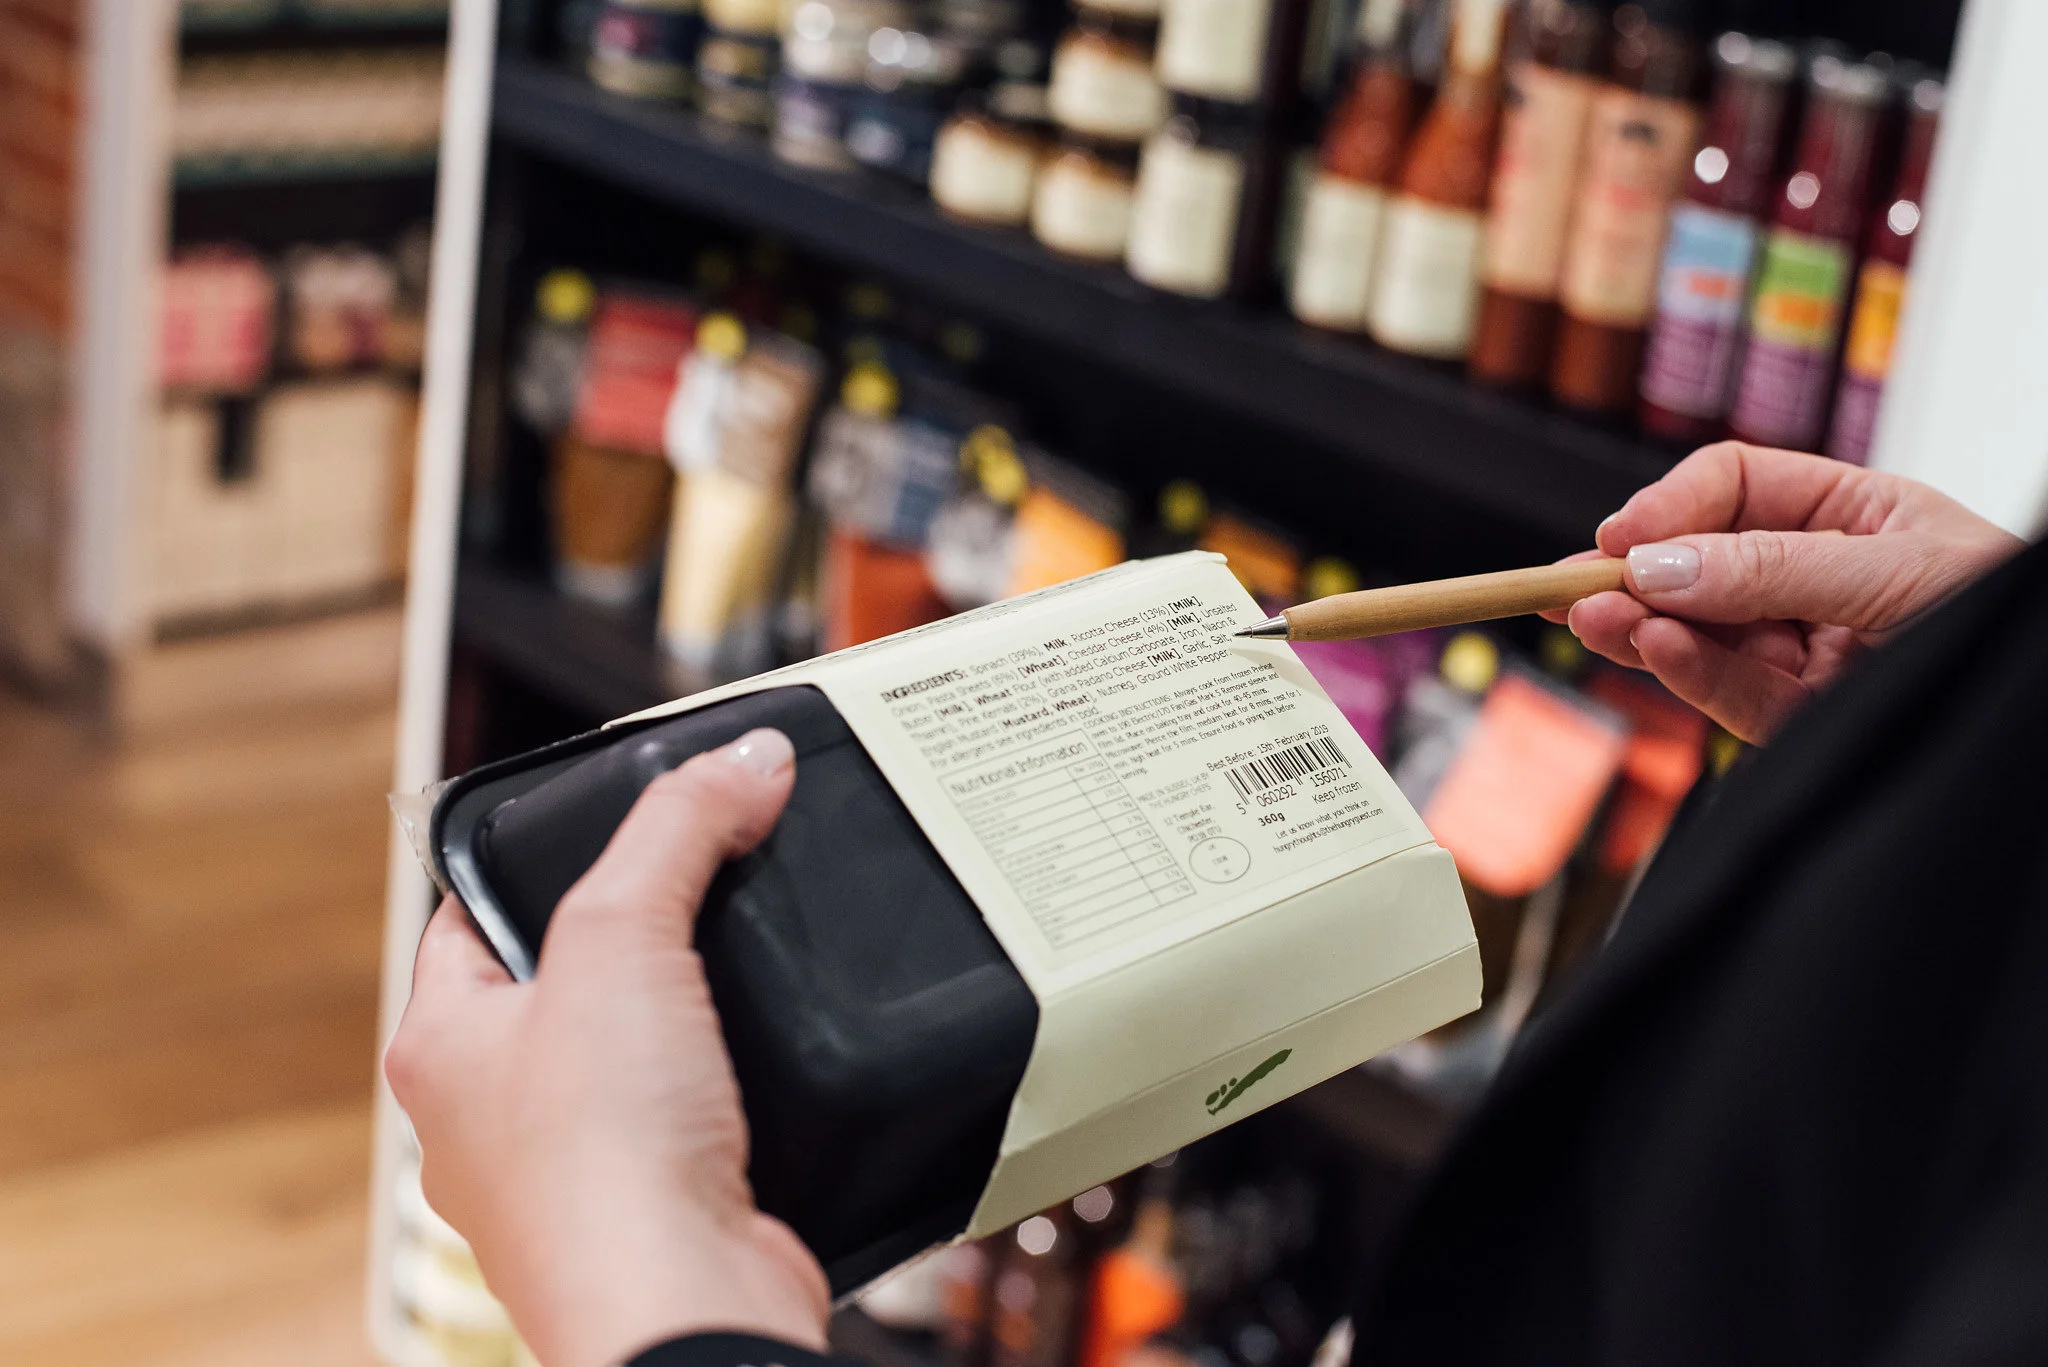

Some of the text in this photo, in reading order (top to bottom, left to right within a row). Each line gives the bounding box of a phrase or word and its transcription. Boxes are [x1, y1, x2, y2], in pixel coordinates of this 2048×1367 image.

[881, 670, 968, 701] INGREDIENTS:
[969, 657, 1008, 675] Spinach
[1043, 638, 1071, 651] Milk,
[1070, 627, 1105, 642] Ricotta
[1104, 616, 1140, 632] Cheese
[1138, 605, 1171, 622] (13%)
[1167, 595, 1203, 614] [Milk],
[955, 680, 992, 696] Sheets
[1017, 654, 1068, 678] [Wheat],
[1067, 642, 1107, 660] Cheddar
[1107, 631, 1144, 647] Cheese
[1142, 621, 1169, 638] (4%)
[1166, 612, 1202, 630] [Milk],
[1200, 603, 1237, 618] Unsalted
[976, 689, 1012, 705] Wheat
[1011, 680, 1036, 693] Flour
[1037, 671, 1064, 687] (with
[1063, 660, 1094, 677] added
[1092, 650, 1130, 667] Calcium
[1128, 636, 1180, 656] Carbonate,
[1178, 628, 1203, 640] Iron,
[1201, 619, 1229, 632] Niacin
[1047, 683, 1078, 698] Grana
[1076, 671, 1113, 688] Padano
[1112, 660, 1148, 676] Cheese
[1147, 648, 1183, 667] [Milk],
[1182, 640, 1212, 654] Garlic,
[1210, 633, 1232, 645] Salt,
[1052, 694, 1096, 712] Wheat],
[1096, 680, 1137, 697] Nutmeg,
[1136, 666, 1171, 684] Ground
[1169, 659, 1198, 673] White
[1196, 649, 1232, 664] Pepper.
[1083, 662, 1274, 729] COOKING INSTRUCTIONS: Always cook from frozen Preheat
[1091, 729, 1108, 738] oven
[1130, 706, 1171, 725] Electric/170
[1169, 698, 1198, 711] Fan/Gas
[1196, 691, 1216, 702] Mark
[1220, 682, 1248, 694] Remove
[1247, 676, 1268, 686] sleeve
[1267, 671, 1279, 680] and
[1067, 714, 1079, 722] in
[1125, 729, 1144, 739] Place
[1145, 725, 1156, 733] on
[1154, 718, 1178, 730] baking
[1176, 713, 1192, 722] tray
[1193, 707, 1206, 716] and
[1205, 701, 1222, 712] cook
[1220, 699, 1232, 707] for
[1233, 691, 1252, 702] 40-45
[1251, 687, 1270, 697] mins.
[1144, 734, 1167, 745] Pierce
[1166, 730, 1179, 738] the
[1178, 724, 1196, 733] film,
[1222, 709, 1238, 718] heat
[1237, 705, 1249, 713] for
[1273, 693, 1287, 702] rest
[1145, 748, 1160, 757] heat
[1160, 744, 1172, 753] for
[1198, 727, 1222, 740] Ensure
[1220, 720, 1238, 731] food
[1245, 713, 1265, 725] piping
[1263, 708, 1276, 717] hot
[1274, 703, 1296, 714] before
[951, 742, 1087, 793] Nutritional Information
[1206, 724, 1329, 771] Best Before: 15th February 2019
[1173, 809, 1200, 821] Temple
[1235, 767, 1347, 815] 5 060292 156071
[1311, 781, 1362, 804] Keep frozen
[1258, 812, 1285, 826] 360g
[1274, 808, 1383, 852] hungrythoughts@thehungryguest.com
[1275, 830, 1288, 839] Let
[1296, 820, 1315, 830] know
[1314, 812, 1333, 824] what
[1332, 809, 1345, 818] you
[1344, 801, 1362, 813] think
